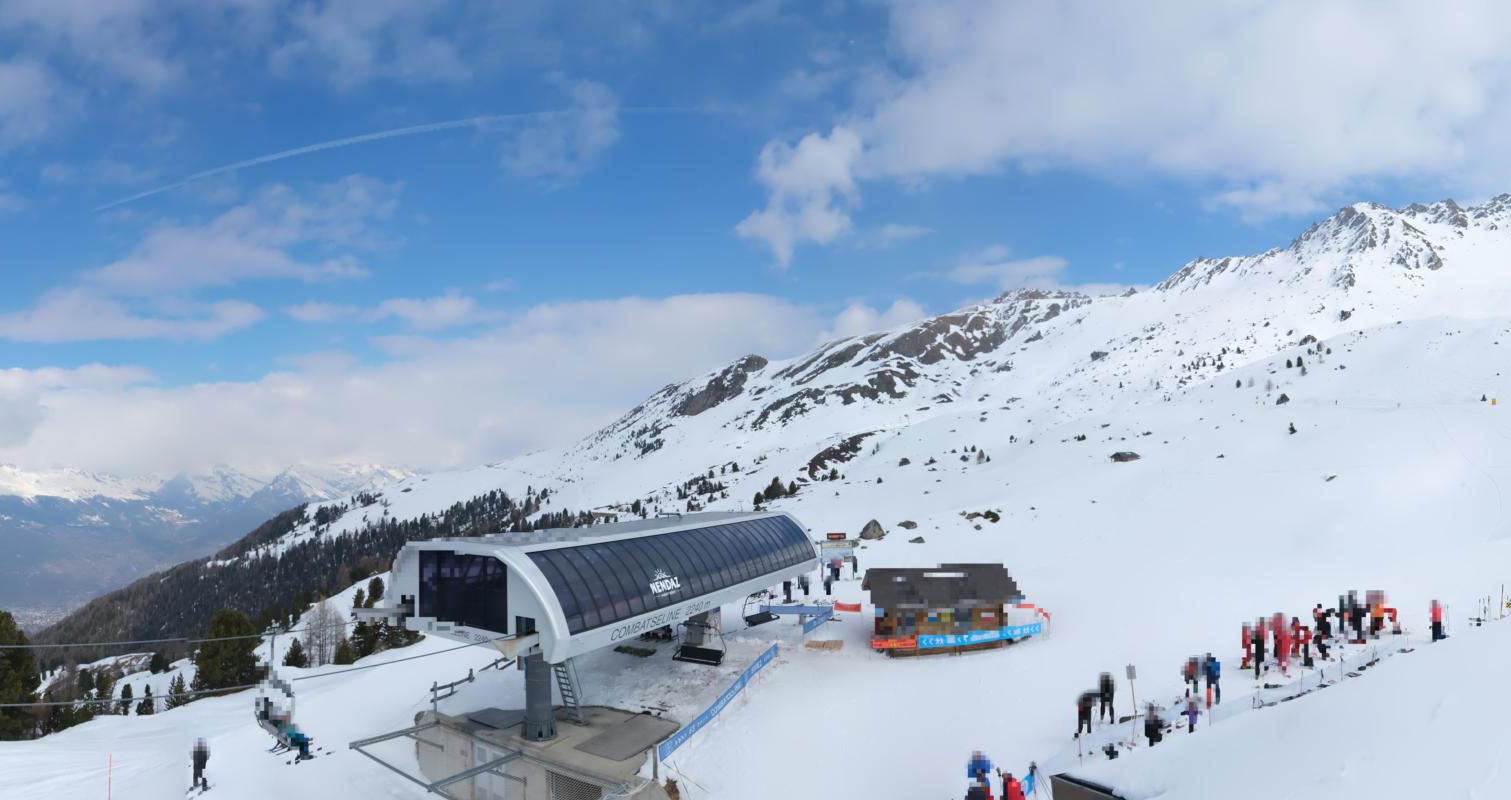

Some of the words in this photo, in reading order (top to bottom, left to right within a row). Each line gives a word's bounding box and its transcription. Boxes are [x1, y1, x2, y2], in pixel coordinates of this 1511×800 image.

[649, 577, 681, 594] NENDAZ
[610, 608, 681, 641] COMBATSELINE
[685, 604, 703, 616] 2240
